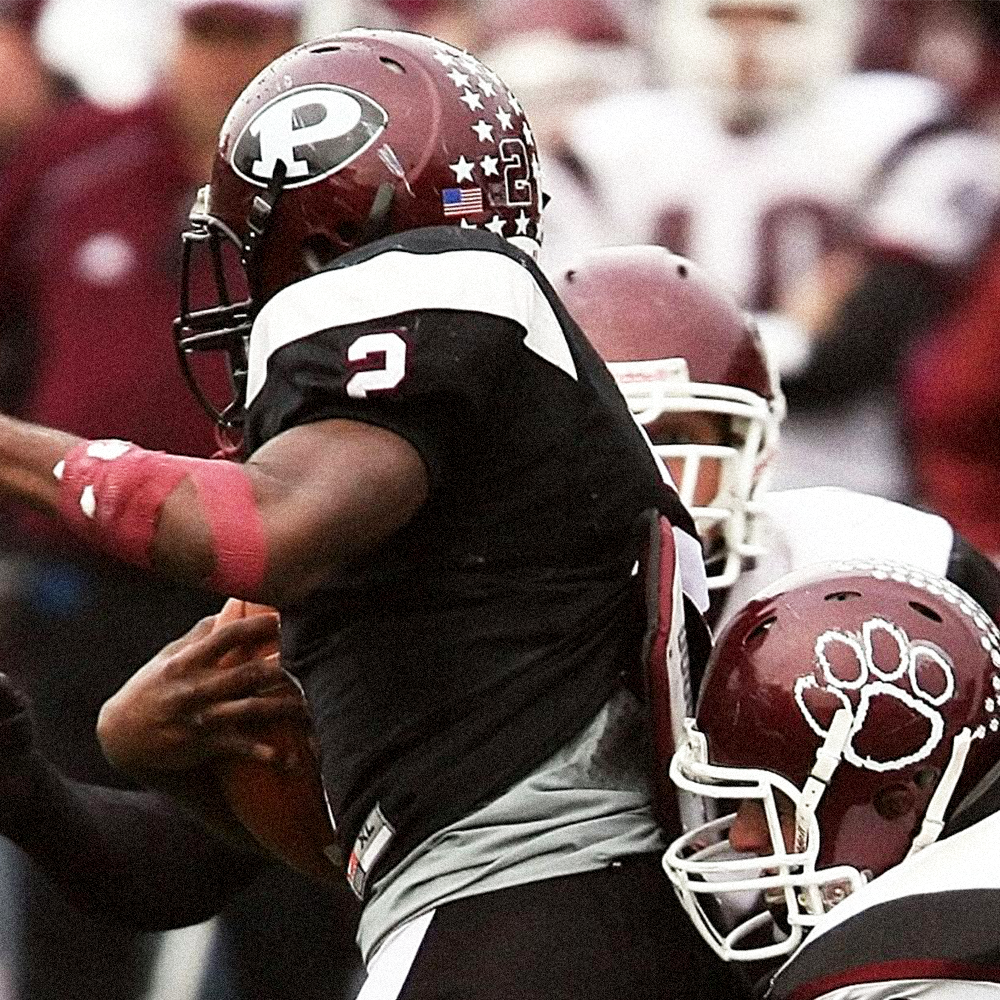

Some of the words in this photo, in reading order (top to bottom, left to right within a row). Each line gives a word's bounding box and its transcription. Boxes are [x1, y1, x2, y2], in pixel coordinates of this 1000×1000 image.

[249, 89, 361, 178] P
[499, 138, 532, 206] 2
[346, 331, 407, 398] 2
